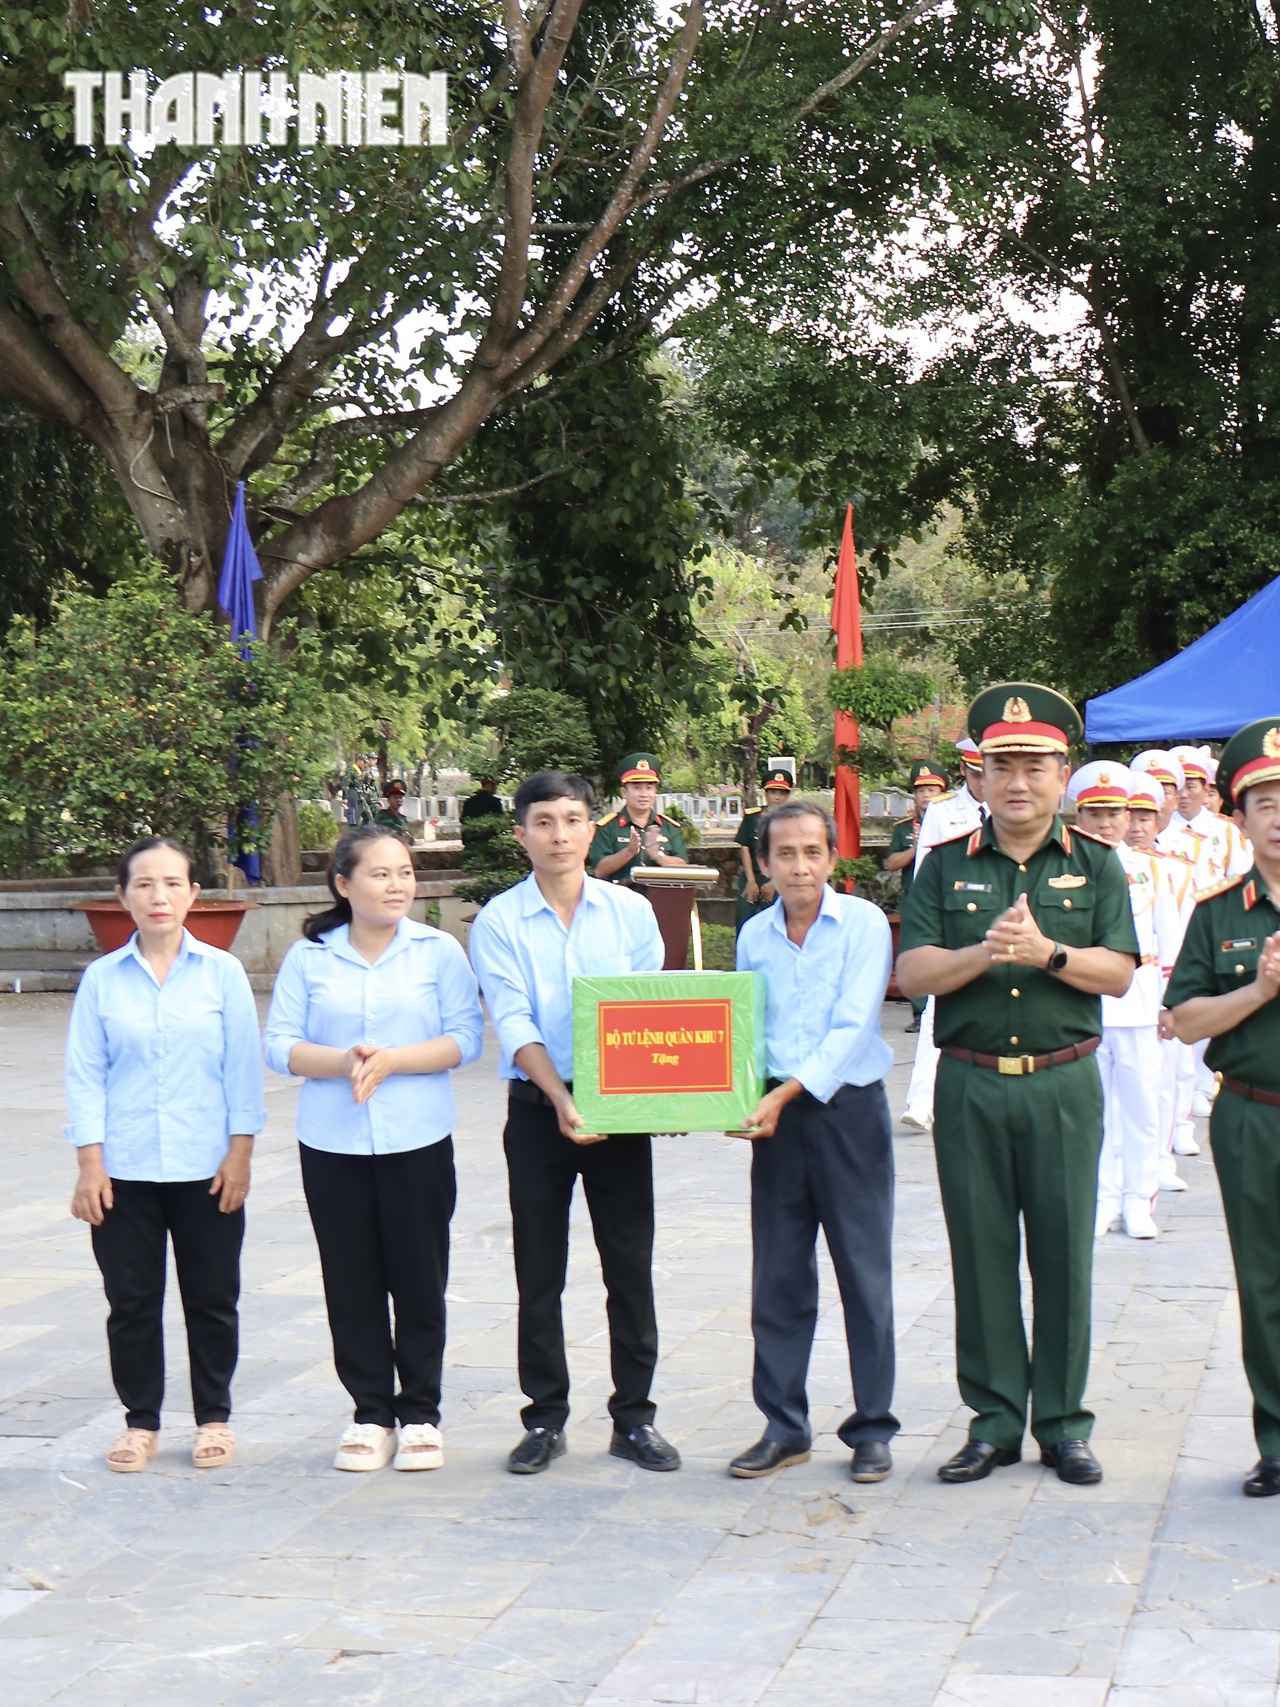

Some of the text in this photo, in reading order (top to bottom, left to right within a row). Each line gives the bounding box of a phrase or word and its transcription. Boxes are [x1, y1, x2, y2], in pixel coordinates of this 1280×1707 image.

[606, 1027, 724, 1048] BỘ TƯ LỆNH QUÂN KHU 7
[651, 1053, 680, 1066] Tặng
